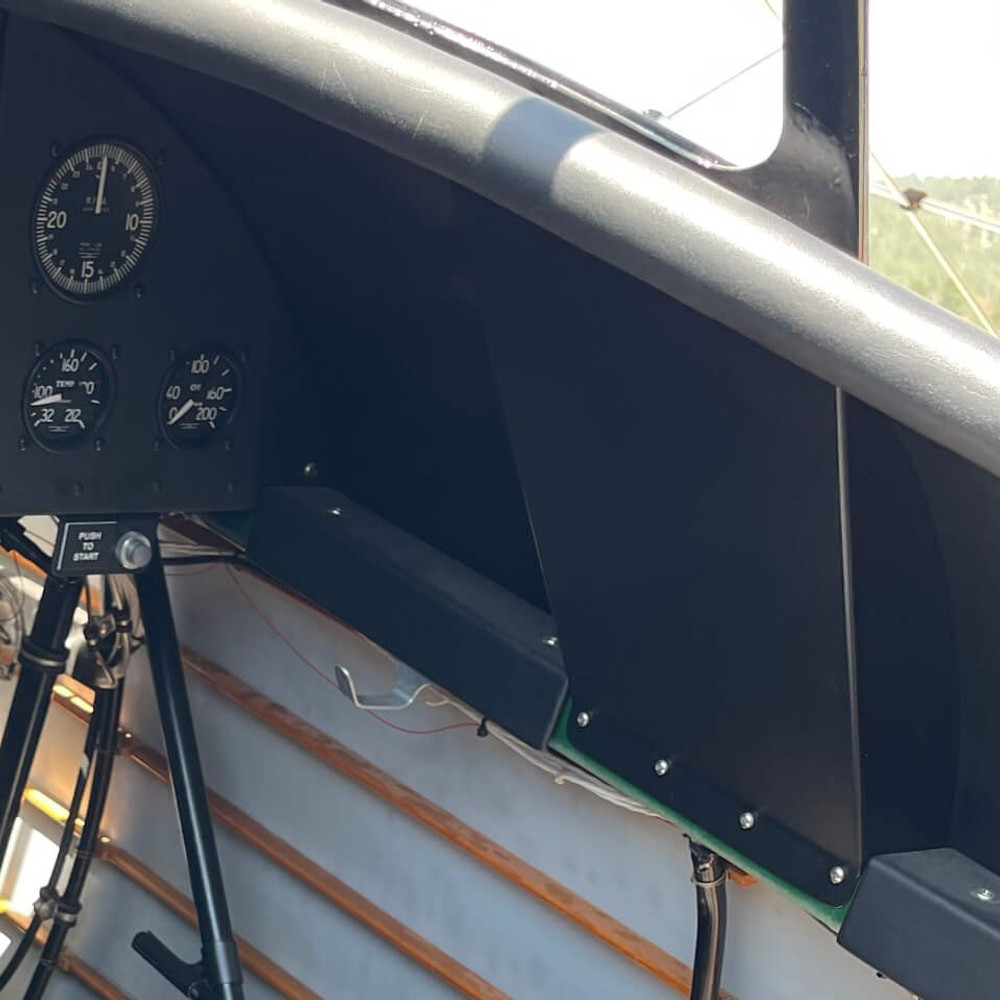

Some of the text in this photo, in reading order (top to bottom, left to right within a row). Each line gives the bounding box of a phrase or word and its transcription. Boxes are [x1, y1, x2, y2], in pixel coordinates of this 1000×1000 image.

[47, 211, 67, 229] 20
[125, 213, 139, 232] 10
[81, 260, 94, 278] 15
[62, 358, 80, 372] 160
[191, 359, 210, 374] 100
[34, 385, 54, 399] 100
[166, 385, 181, 400] 40
[206, 386, 225, 401] 160
[40, 408, 55, 422] 32
[195, 407, 218, 421] 200
[78, 531, 103, 541] PUSH
[82, 541, 95, 551] TO
[72, 551, 101, 562] START
